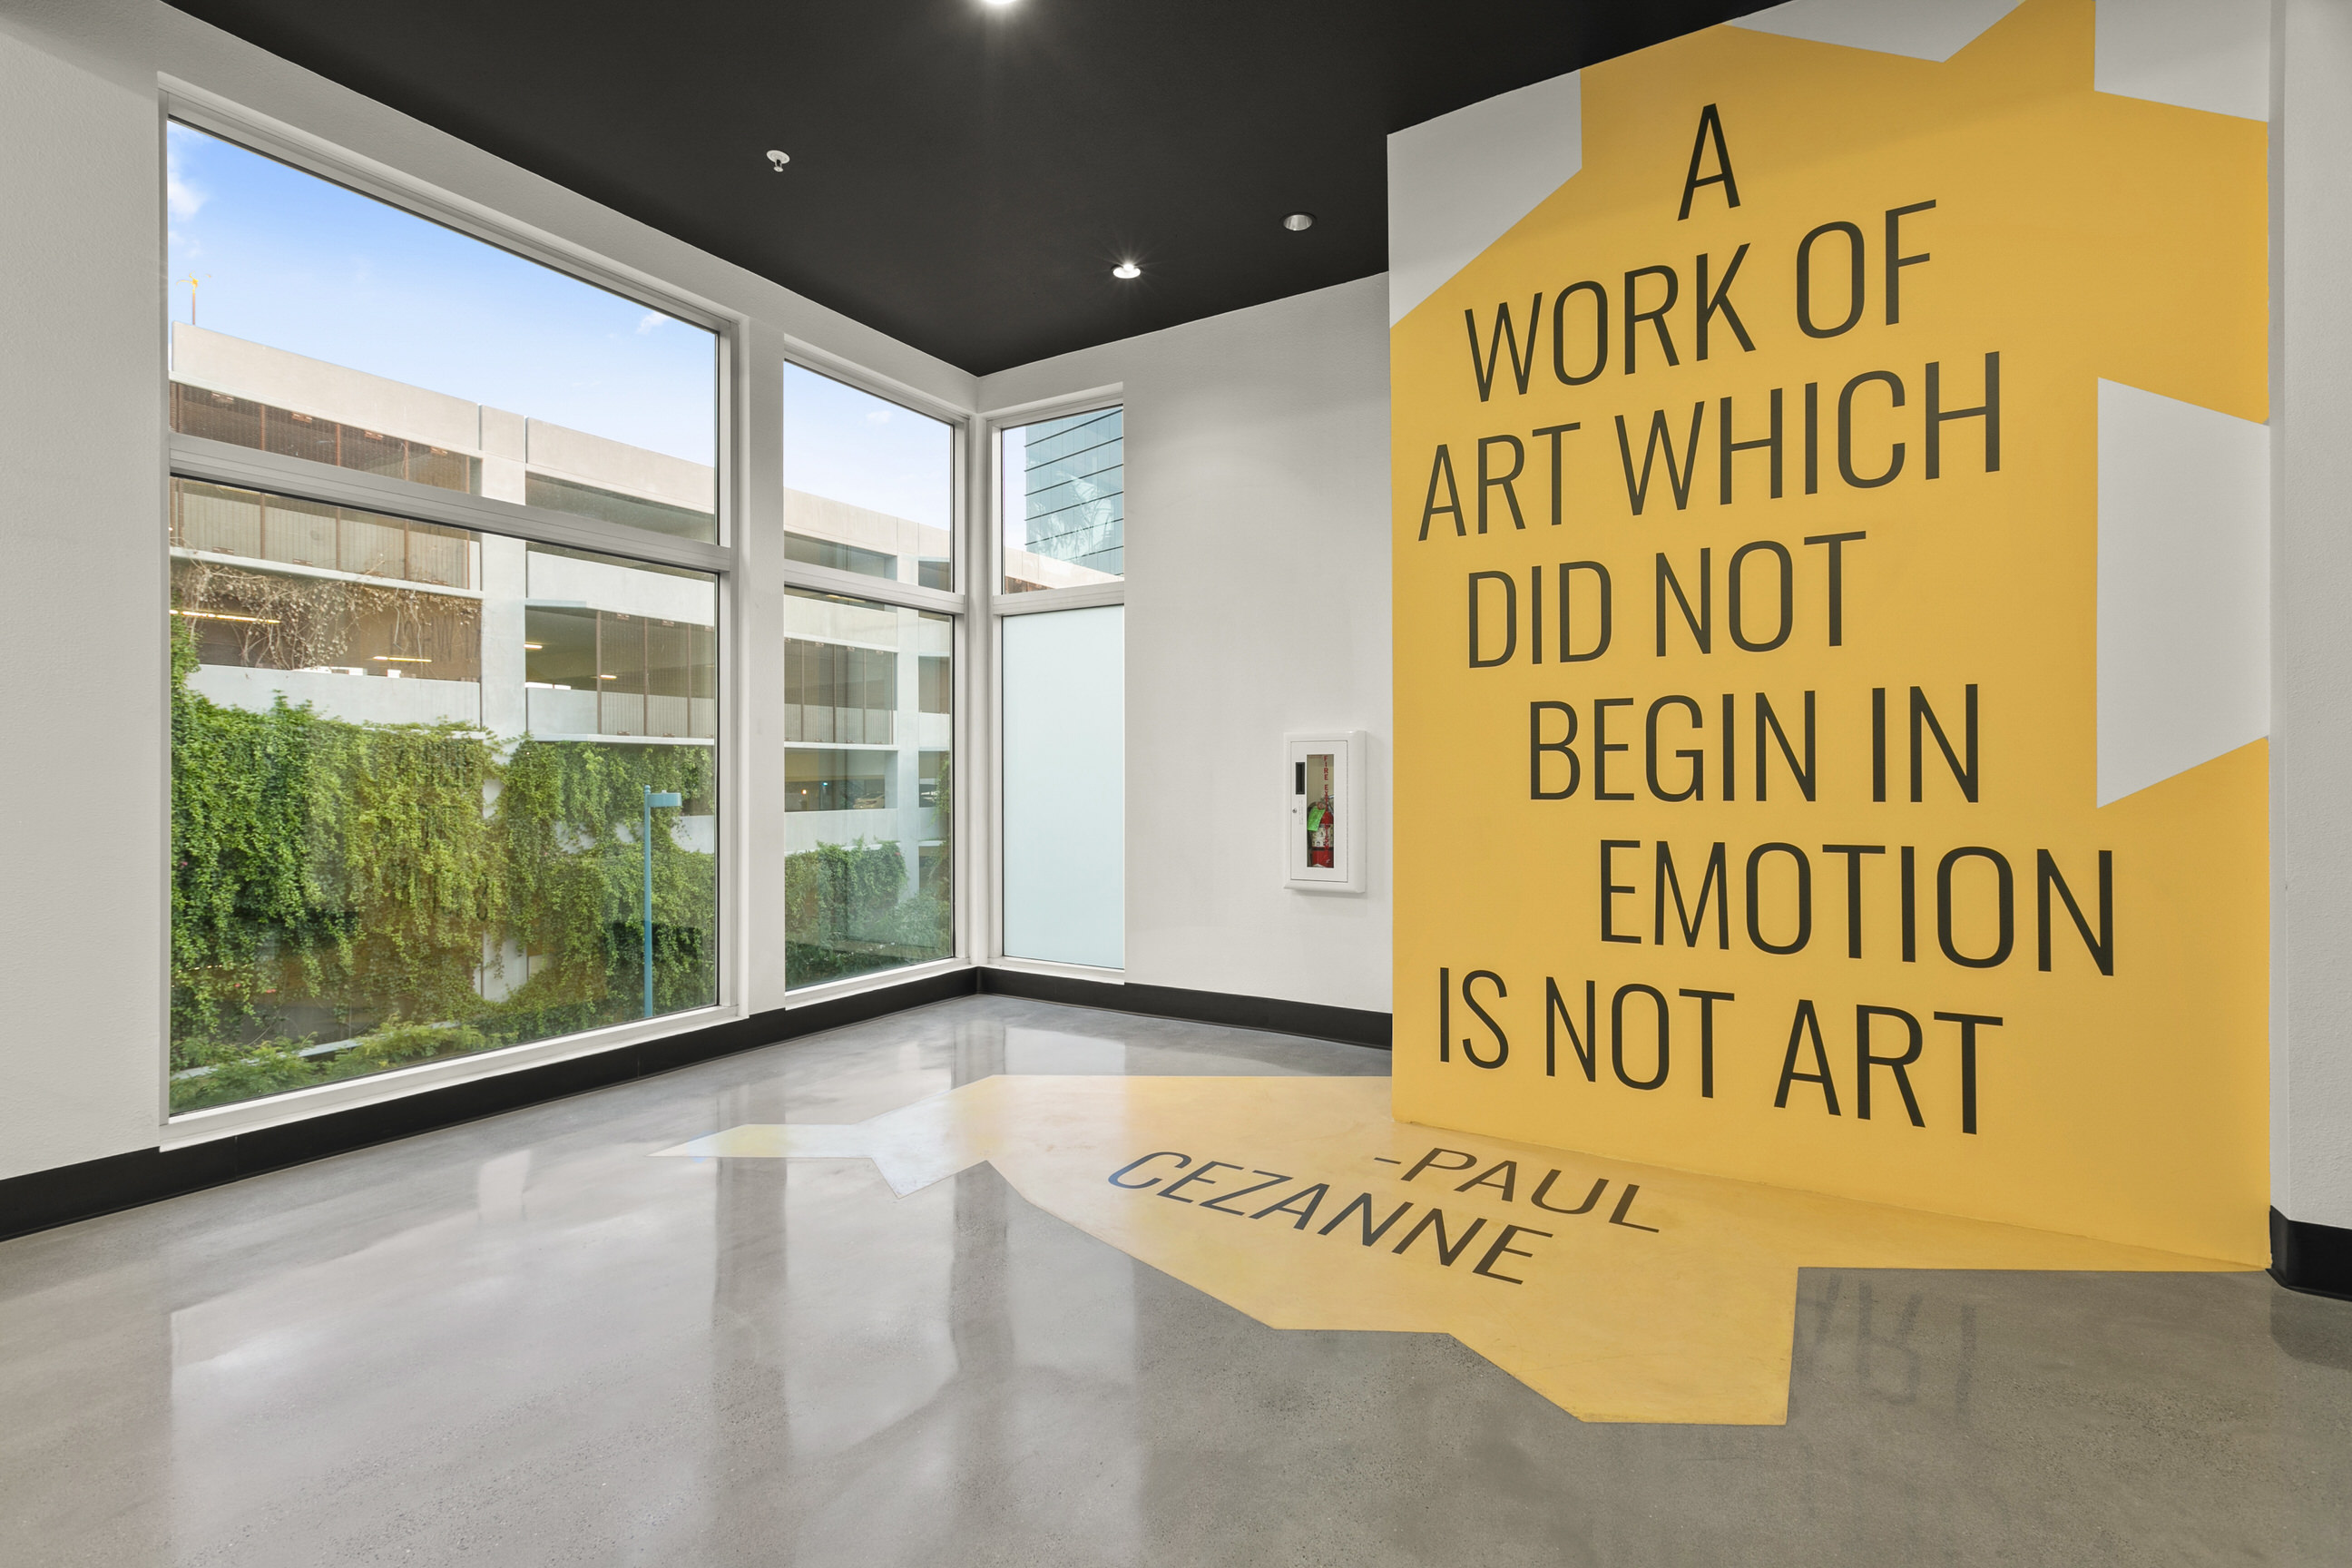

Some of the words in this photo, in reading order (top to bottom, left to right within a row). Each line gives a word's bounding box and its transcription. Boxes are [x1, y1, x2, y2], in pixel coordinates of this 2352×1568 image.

[1678, 103, 1741, 221] A
[1465, 242, 1757, 403] WORK
[1796, 199, 1936, 339] OF
[1418, 422, 1581, 542] ART
[1614, 351, 2000, 516] WHICH
[1468, 561, 1612, 669] DID
[1656, 531, 1867, 657] NOT
[1530, 690, 1816, 802] BEGIN
[1872, 683, 1979, 803] IN
[1600, 839, 2114, 976] EMOTION
[1440, 967, 1509, 1070] IS
[1545, 976, 1735, 1099] NOT
[1774, 999, 2004, 1135] ART
[1107, 1152, 1553, 1285] CEZANNE
[1374, 1147, 1660, 1233] -PAUL
